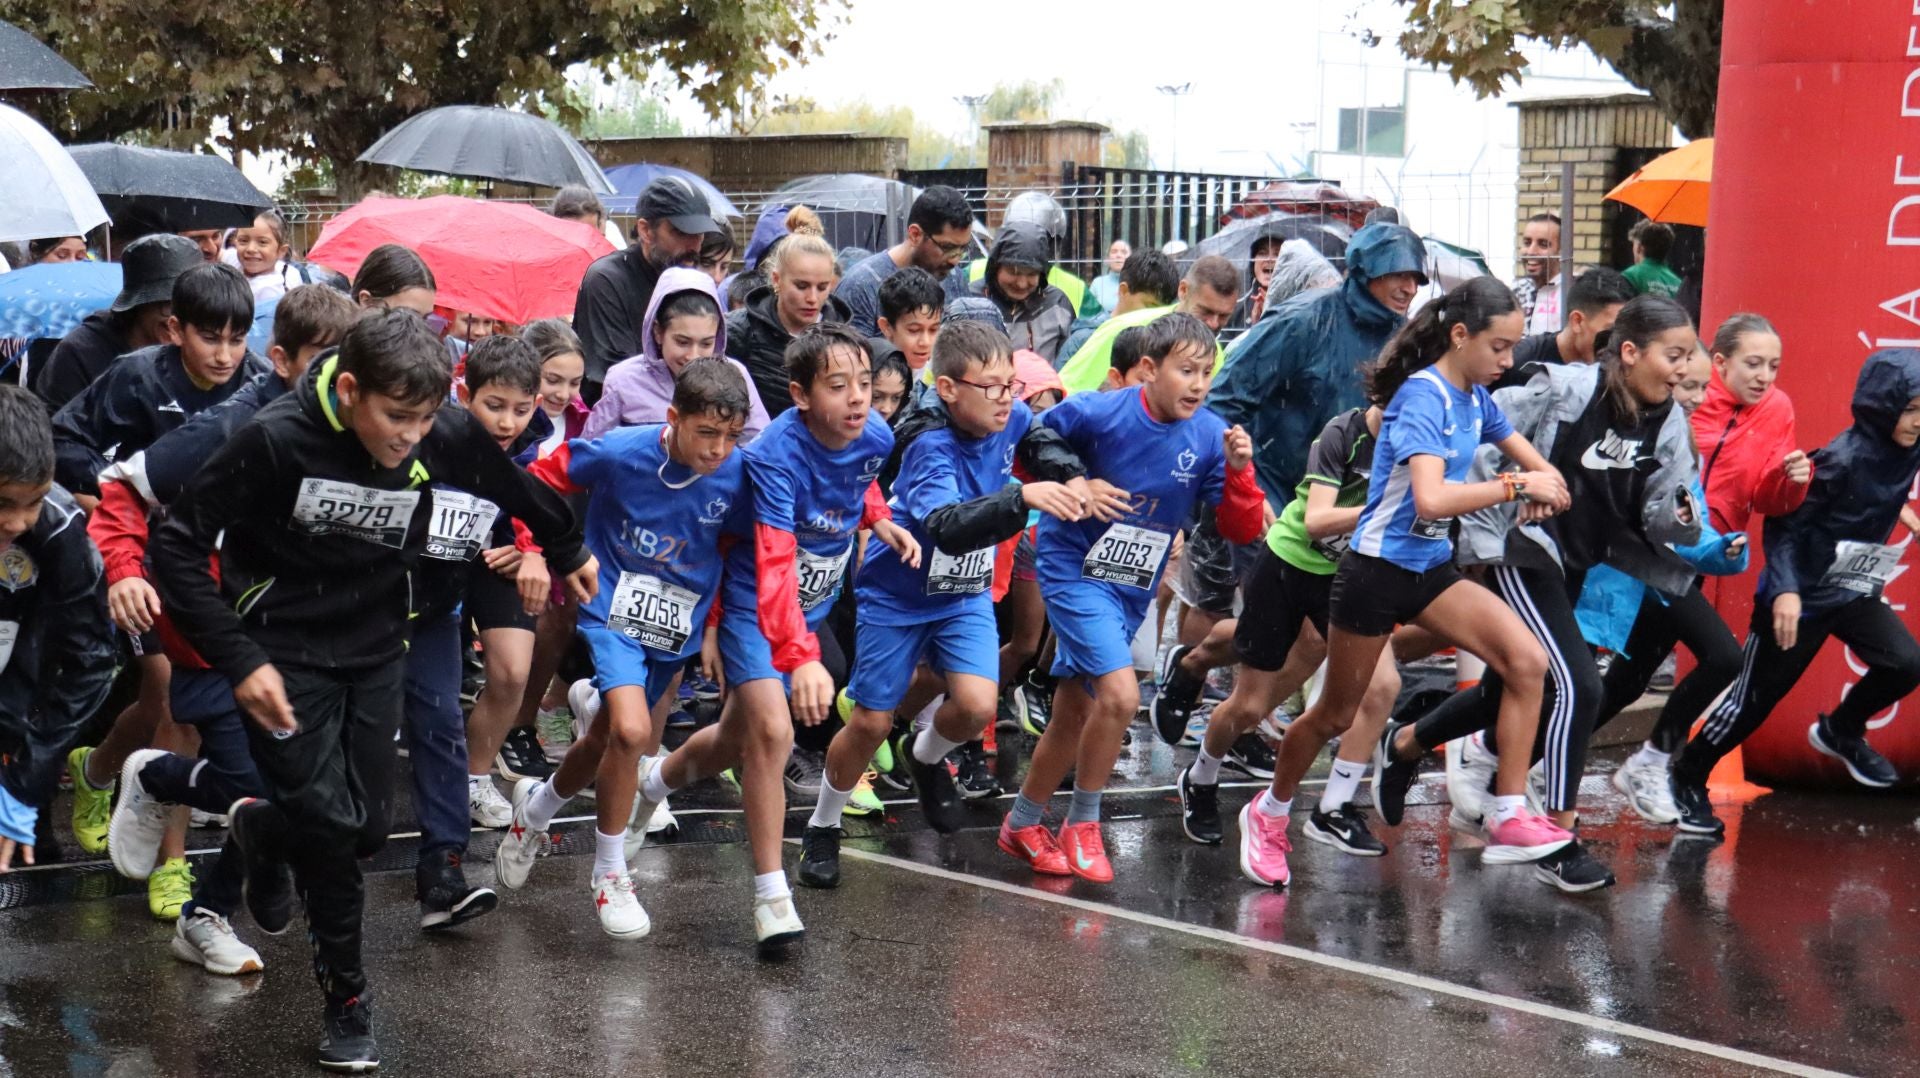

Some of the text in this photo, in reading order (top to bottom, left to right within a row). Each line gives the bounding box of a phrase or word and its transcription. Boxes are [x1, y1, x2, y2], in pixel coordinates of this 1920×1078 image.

[314, 499, 395, 528] 3279
[439, 507, 480, 539] 1129
[620, 519, 689, 562] NB21
[1098, 537, 1153, 568] 3063
[1105, 570, 1140, 584] HYUNDAI
[627, 589, 680, 630] 3058
[641, 631, 675, 647] HYUNDAI
